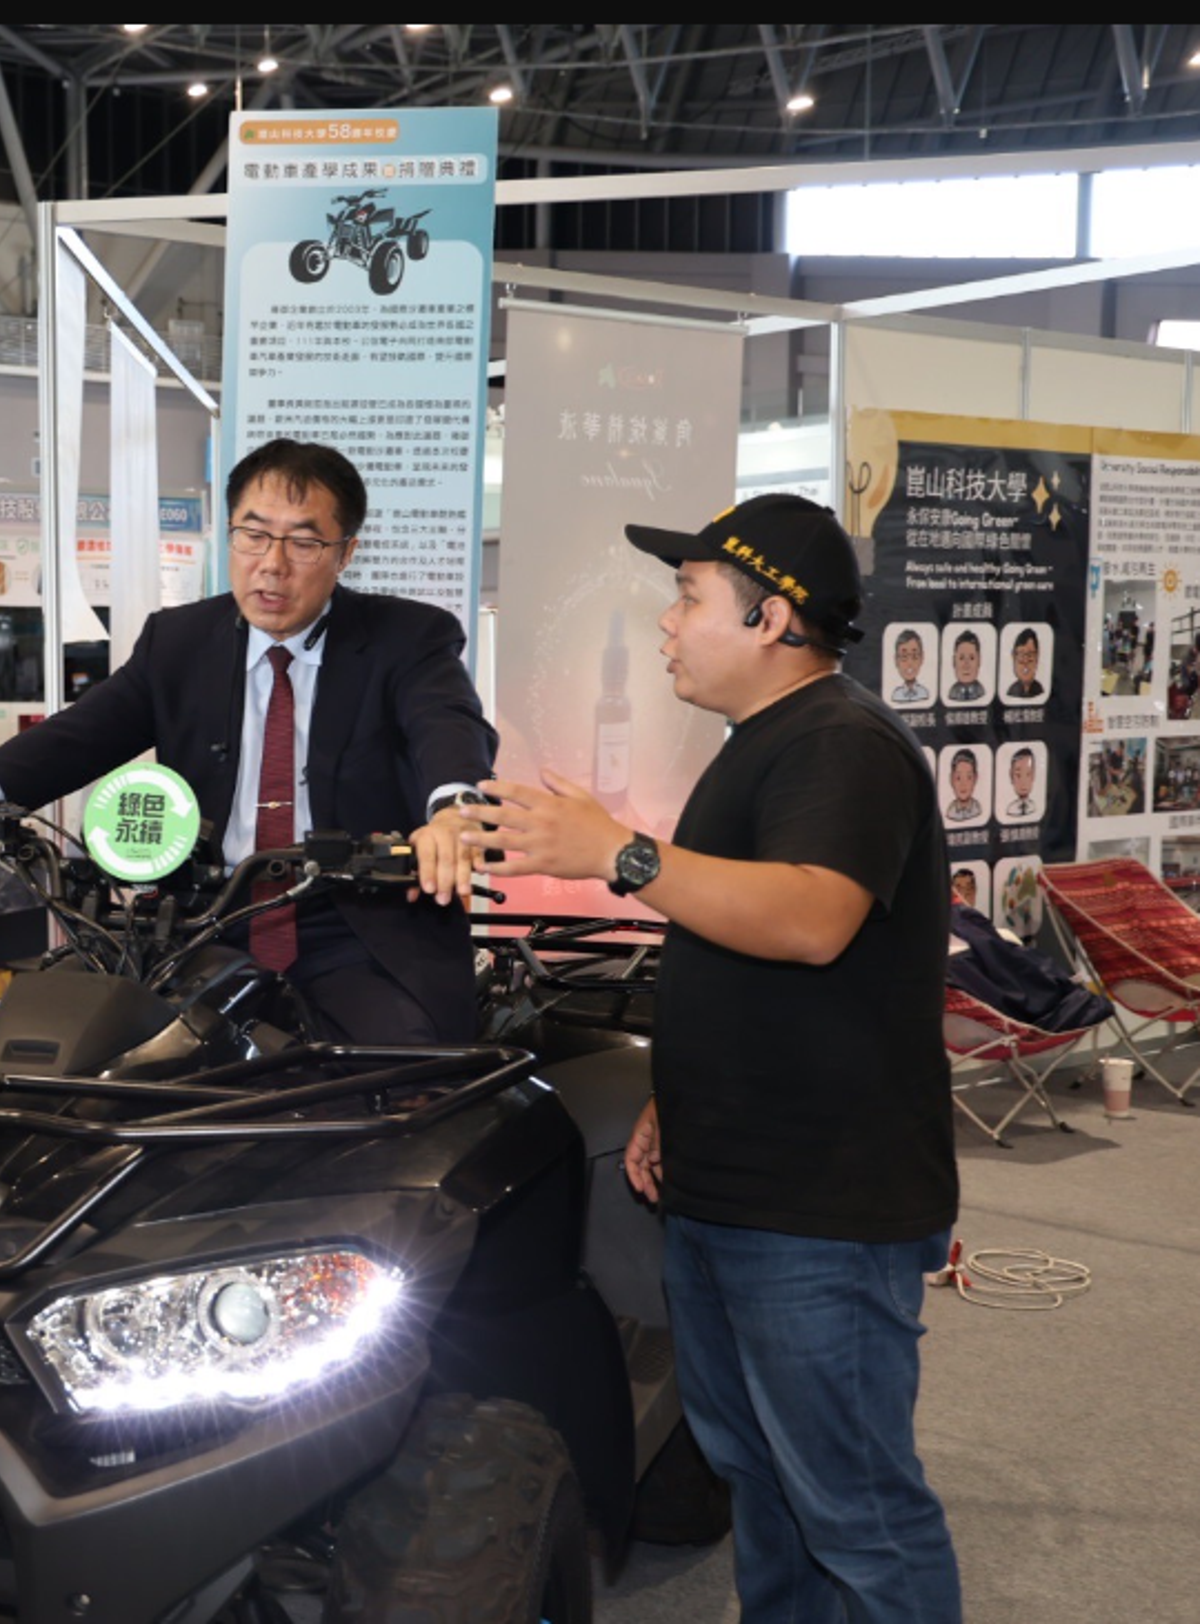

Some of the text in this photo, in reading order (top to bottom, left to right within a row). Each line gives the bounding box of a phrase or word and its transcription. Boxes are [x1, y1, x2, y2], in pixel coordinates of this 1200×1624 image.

[905, 465, 1027, 503] 崑山科技大學
[117, 792, 165, 818] 綠色
[115, 818, 163, 844] 永續
